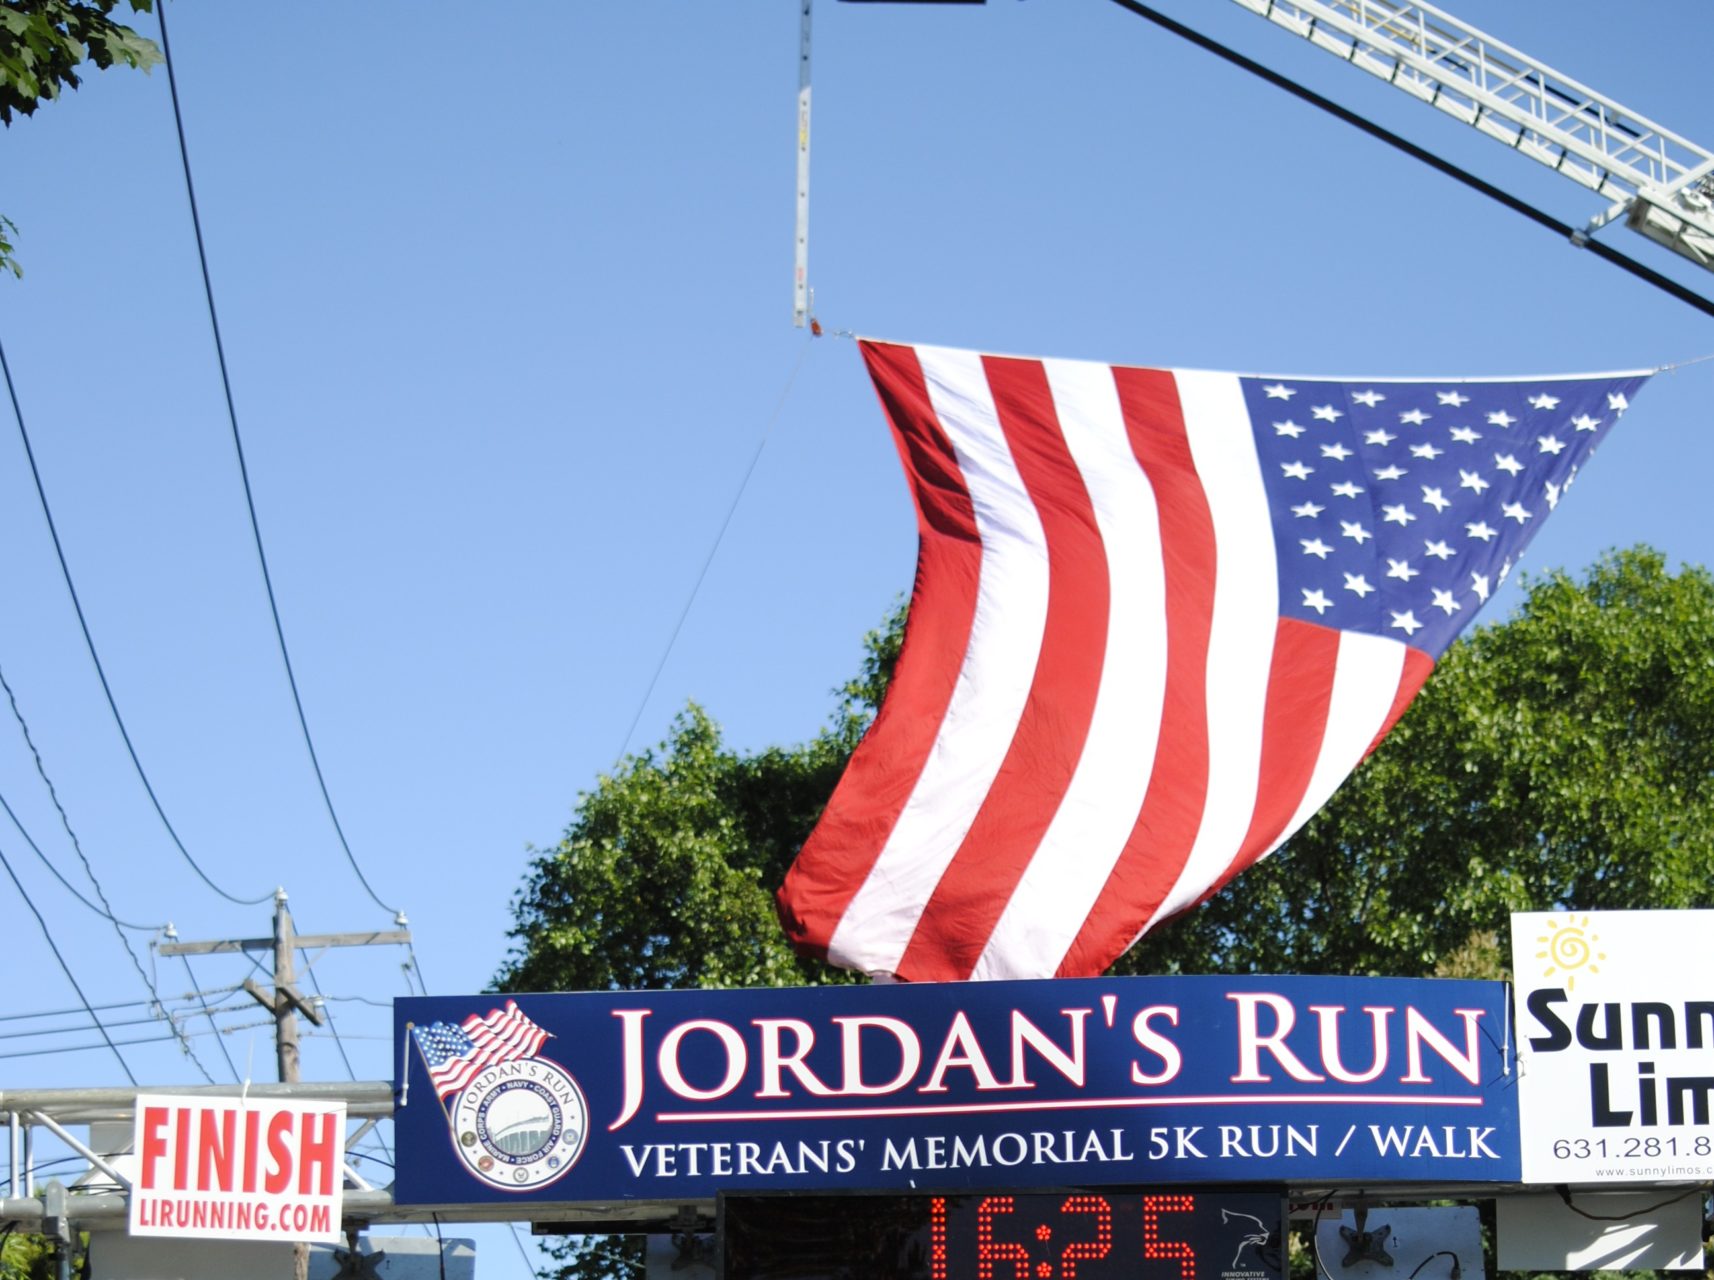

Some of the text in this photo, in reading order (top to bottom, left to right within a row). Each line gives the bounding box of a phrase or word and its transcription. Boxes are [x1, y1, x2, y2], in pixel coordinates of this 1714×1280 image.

[607, 992, 1486, 1132] JORDAN'S RUN
[463, 1062, 574, 1113] JORDAN'S RUN
[483, 1085, 502, 1106] ARMY
[506, 1081, 528, 1089] NAVY
[533, 1085, 557, 1106] COAST
[478, 1112, 487, 1140] CORPS
[552, 1107, 562, 1136] GUARD
[140, 1106, 337, 1196] FINISH
[482, 1139, 510, 1163] MARINE
[516, 1153, 543, 1164] FORCE
[620, 1124, 1500, 1178] VETERANS' MEMORIAL 5K RUN / WALK
[1554, 1136, 1712, 1159] 631.281.8
[139, 1198, 331, 1233] LIRUNNING.COM
